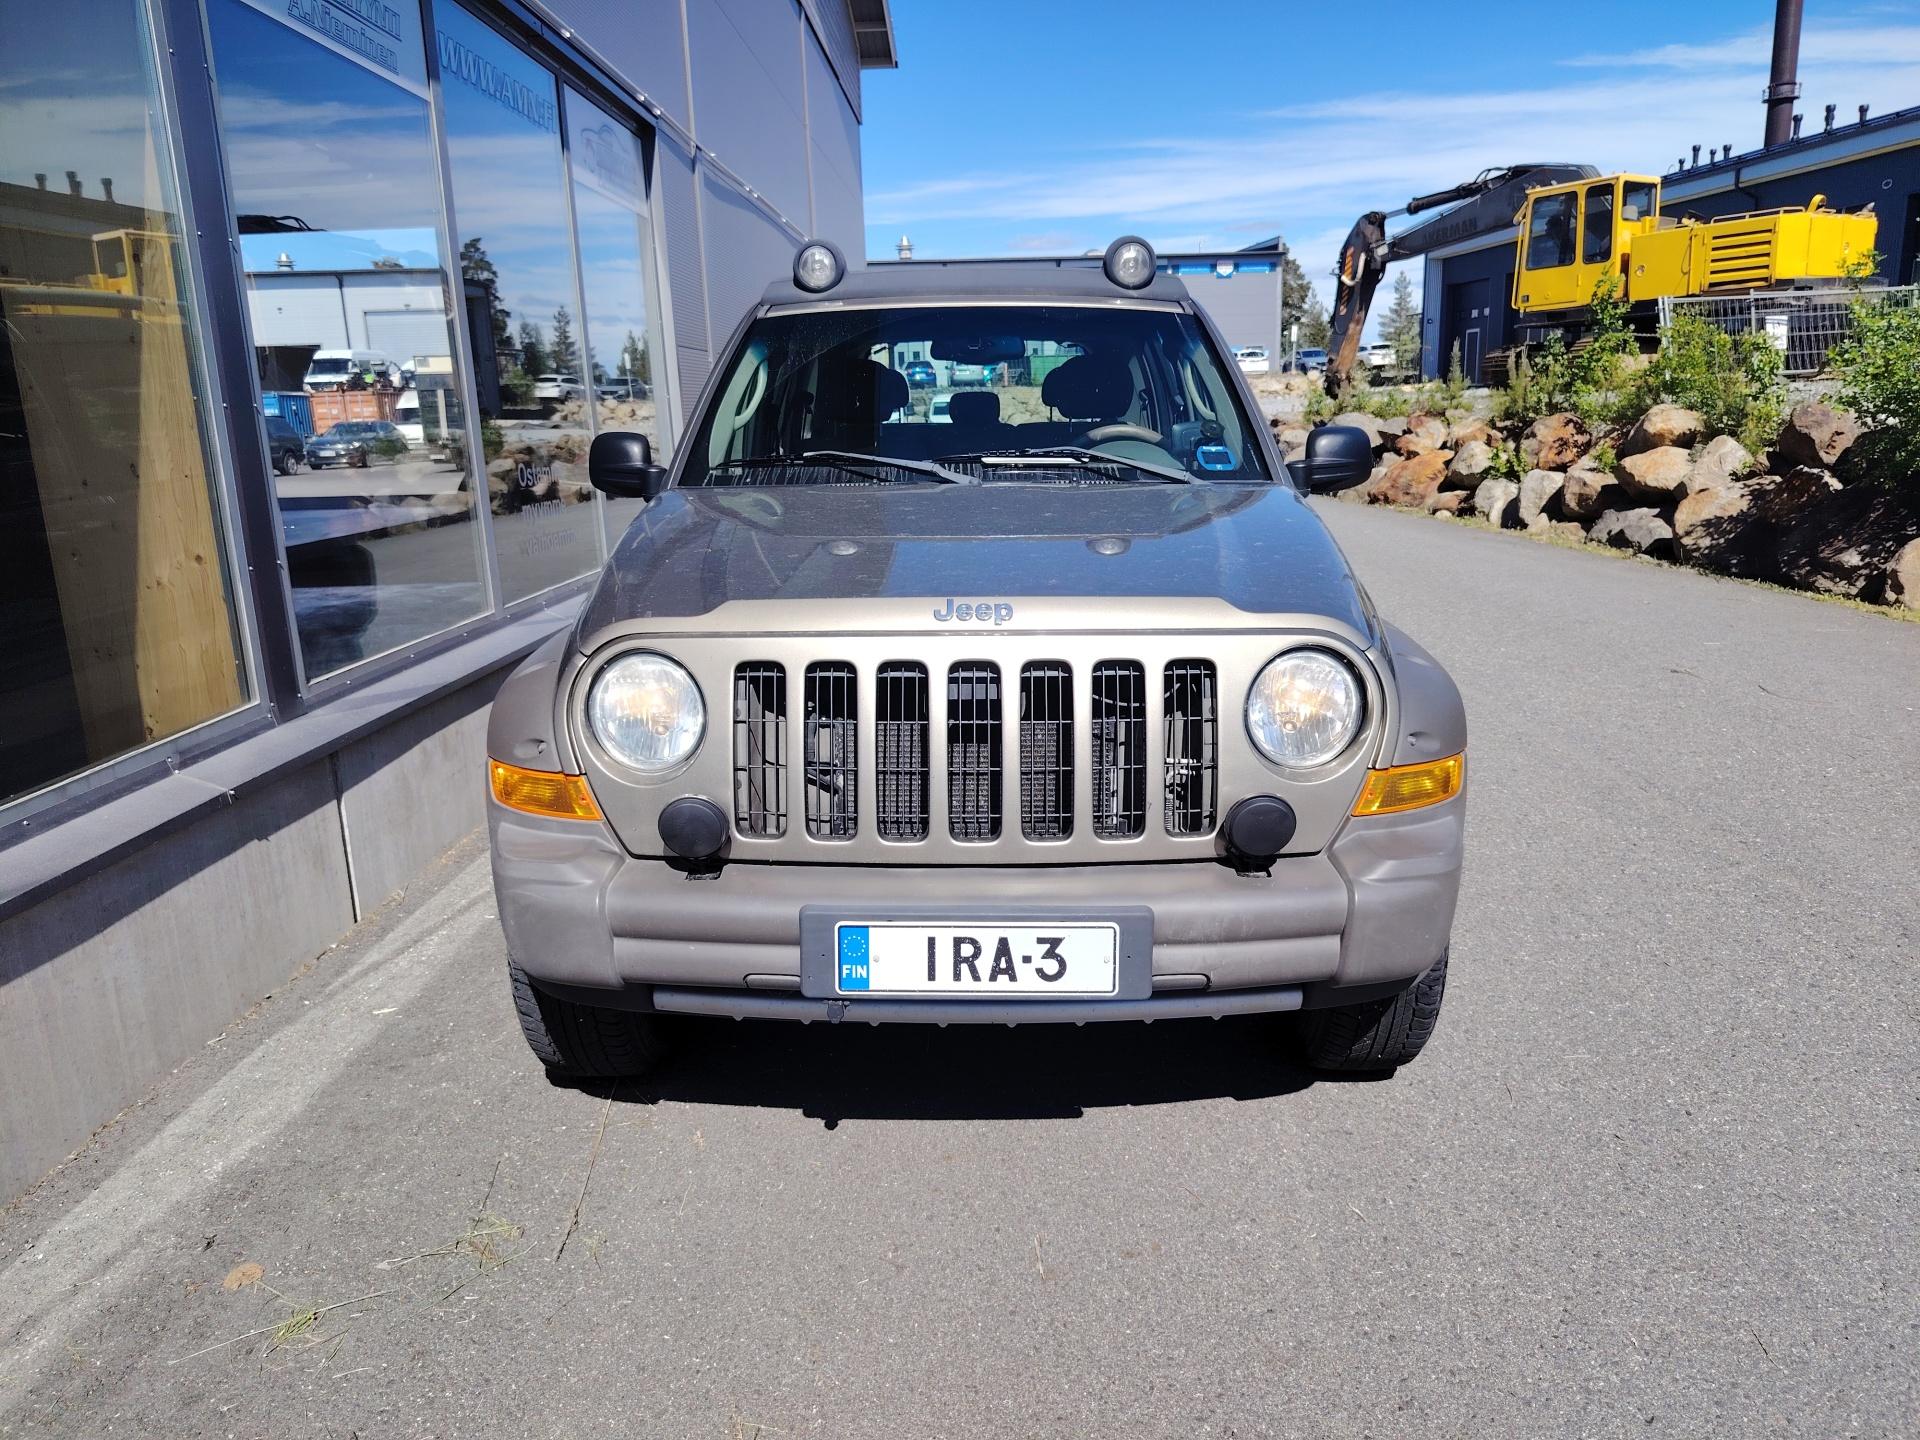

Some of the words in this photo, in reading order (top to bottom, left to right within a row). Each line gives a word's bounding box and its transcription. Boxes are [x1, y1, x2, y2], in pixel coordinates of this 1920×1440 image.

[933, 598, 1014, 626] Jeep
[842, 964, 867, 979] FIN
[926, 936, 1068, 983] IRA-3
